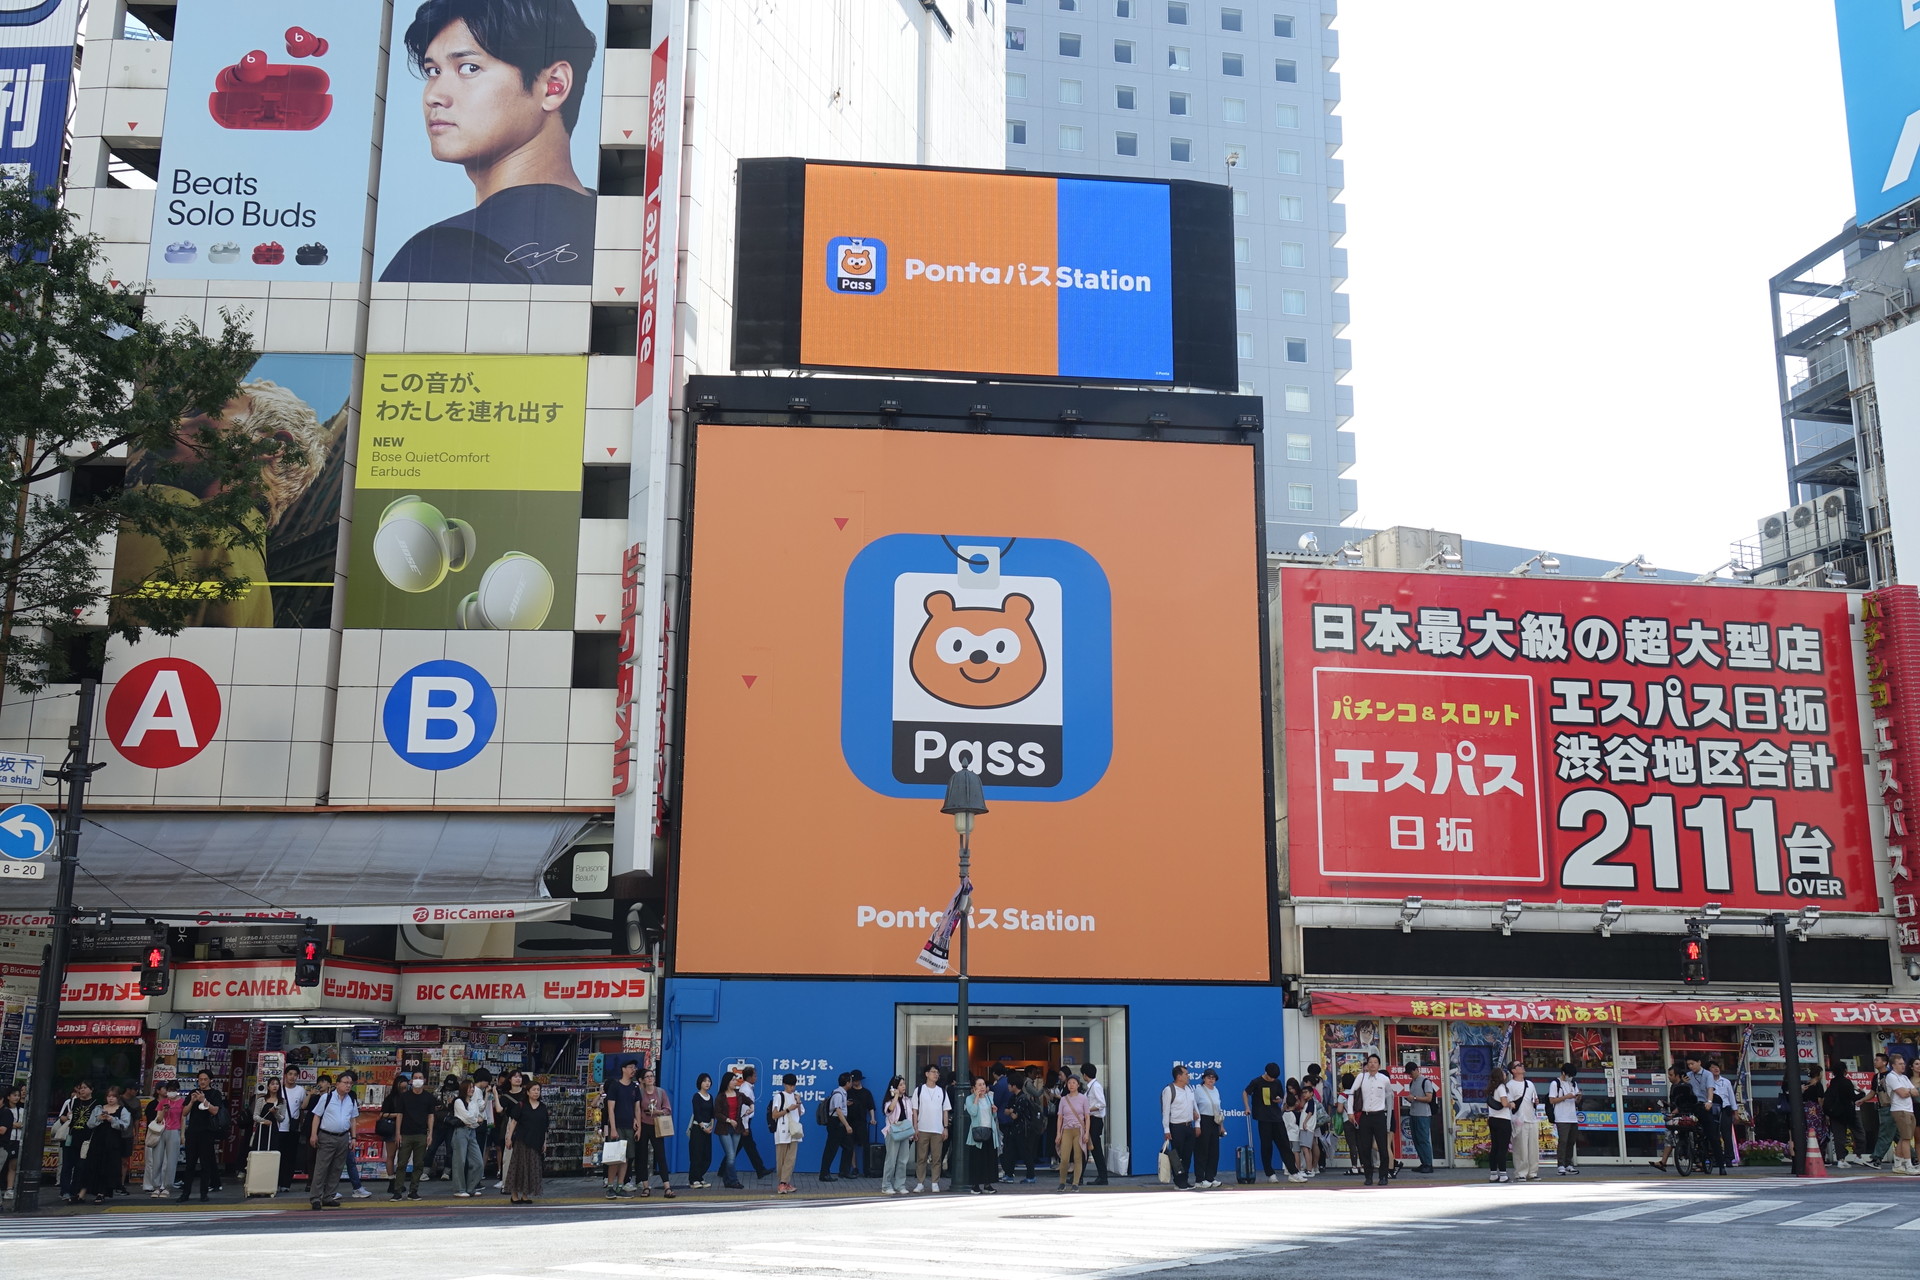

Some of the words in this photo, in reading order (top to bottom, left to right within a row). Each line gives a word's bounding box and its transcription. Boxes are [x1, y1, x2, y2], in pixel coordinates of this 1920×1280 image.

[649, 80, 667, 152] 免税
[172, 169, 258, 196] Beats
[167, 199, 235, 226] Solo
[242, 201, 317, 228] Buds
[842, 278, 872, 292] Pass
[380, 371, 481, 394] この音が、
[376, 400, 564, 424] わたしを連れ出す
[373, 437, 405, 447] NEW
[372, 452, 402, 462] Bose
[405, 452, 491, 463] QuietComfort
[371, 466, 421, 477] Earbuds
[1312, 604, 1824, 673] 日本最大級の超大型店
[121, 670, 199, 748] A
[406, 676, 476, 754] B
[1331, 695, 1520, 727] パチンコ&スロット
[914, 730, 1046, 778] Pass
[1556, 733, 1834, 790] 渋谷地区合計
[1333, 739, 1525, 798] エスパス
[10, 775, 33, 785] shita
[1872, 718, 1912, 883] エスパス
[575, 864, 607, 873] Panasonic
[575, 873, 598, 883] Beauty
[1786, 877, 1843, 897] OVER
[433, 907, 515, 921] BicCamera
[9, 966, 41, 976] BicCamera
[192, 981, 221, 998] BIC
[225, 979, 301, 997] CAMERA
[324, 977, 393, 1002] ビックカメラ
[416, 984, 445, 1000] BIC
[449, 983, 527, 1000] CAMERA
[543, 979, 646, 999] ビックカメラ
[1696, 1005, 1819, 1022] パチンコ&スット
[101, 1024, 136, 1033] BicCamera
[174, 1033, 201, 1043] ANKER
[1757, 1049, 1770, 1057] OK
[772, 1058, 834, 1071] 「おトク」を、
[772, 1074, 817, 1087] 踏出す
[1599, 1113, 1613, 1122] OK
[1651, 1114, 1665, 1123] OK
